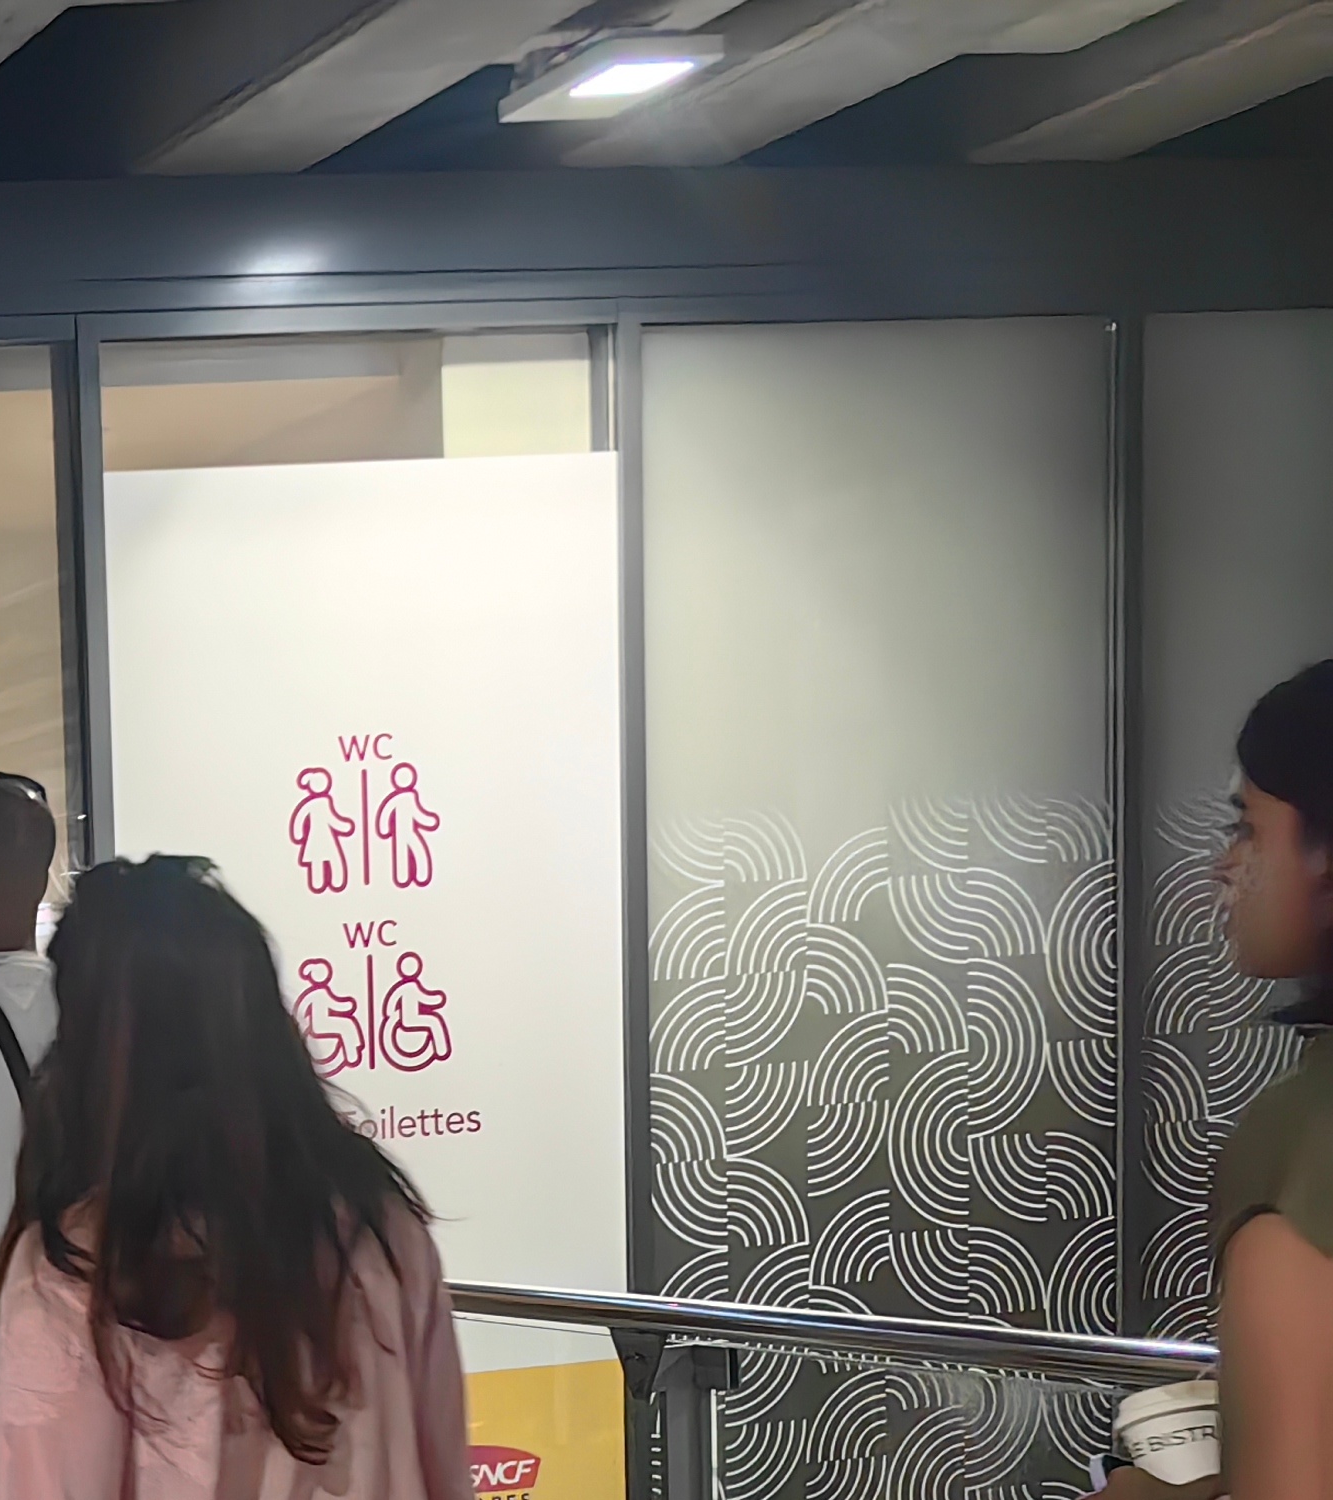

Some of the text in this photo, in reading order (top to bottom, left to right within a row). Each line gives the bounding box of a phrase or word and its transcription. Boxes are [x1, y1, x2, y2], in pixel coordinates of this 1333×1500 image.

[337, 732, 394, 763] WC
[341, 919, 398, 949] WC
[469, 1458, 536, 1489] SNCF
